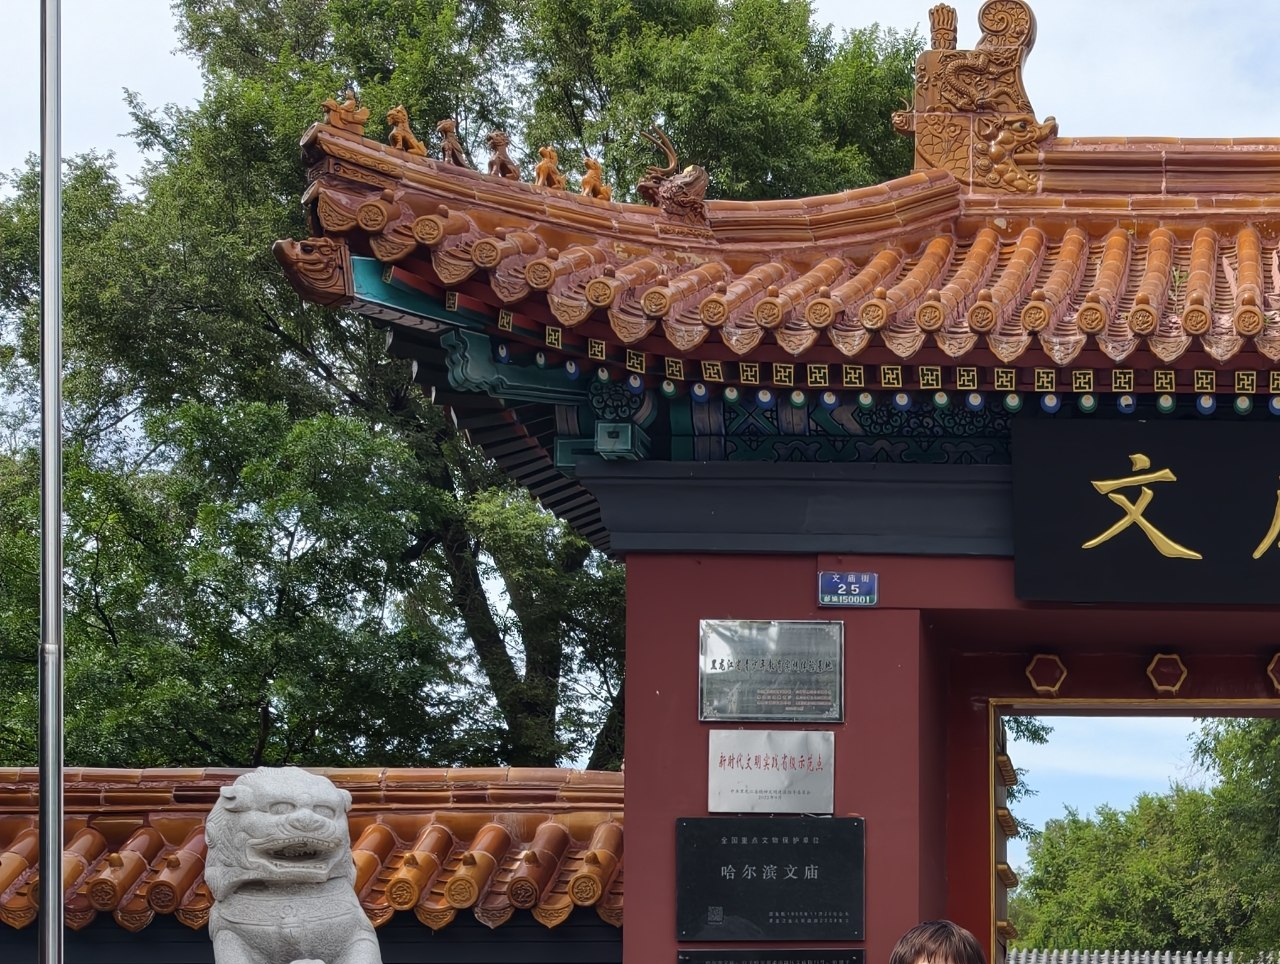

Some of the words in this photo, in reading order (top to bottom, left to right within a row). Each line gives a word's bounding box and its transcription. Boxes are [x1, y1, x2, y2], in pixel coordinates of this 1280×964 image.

[837, 583, 860, 595] 25
[721, 864, 819, 880] 哈尔滨文庙
